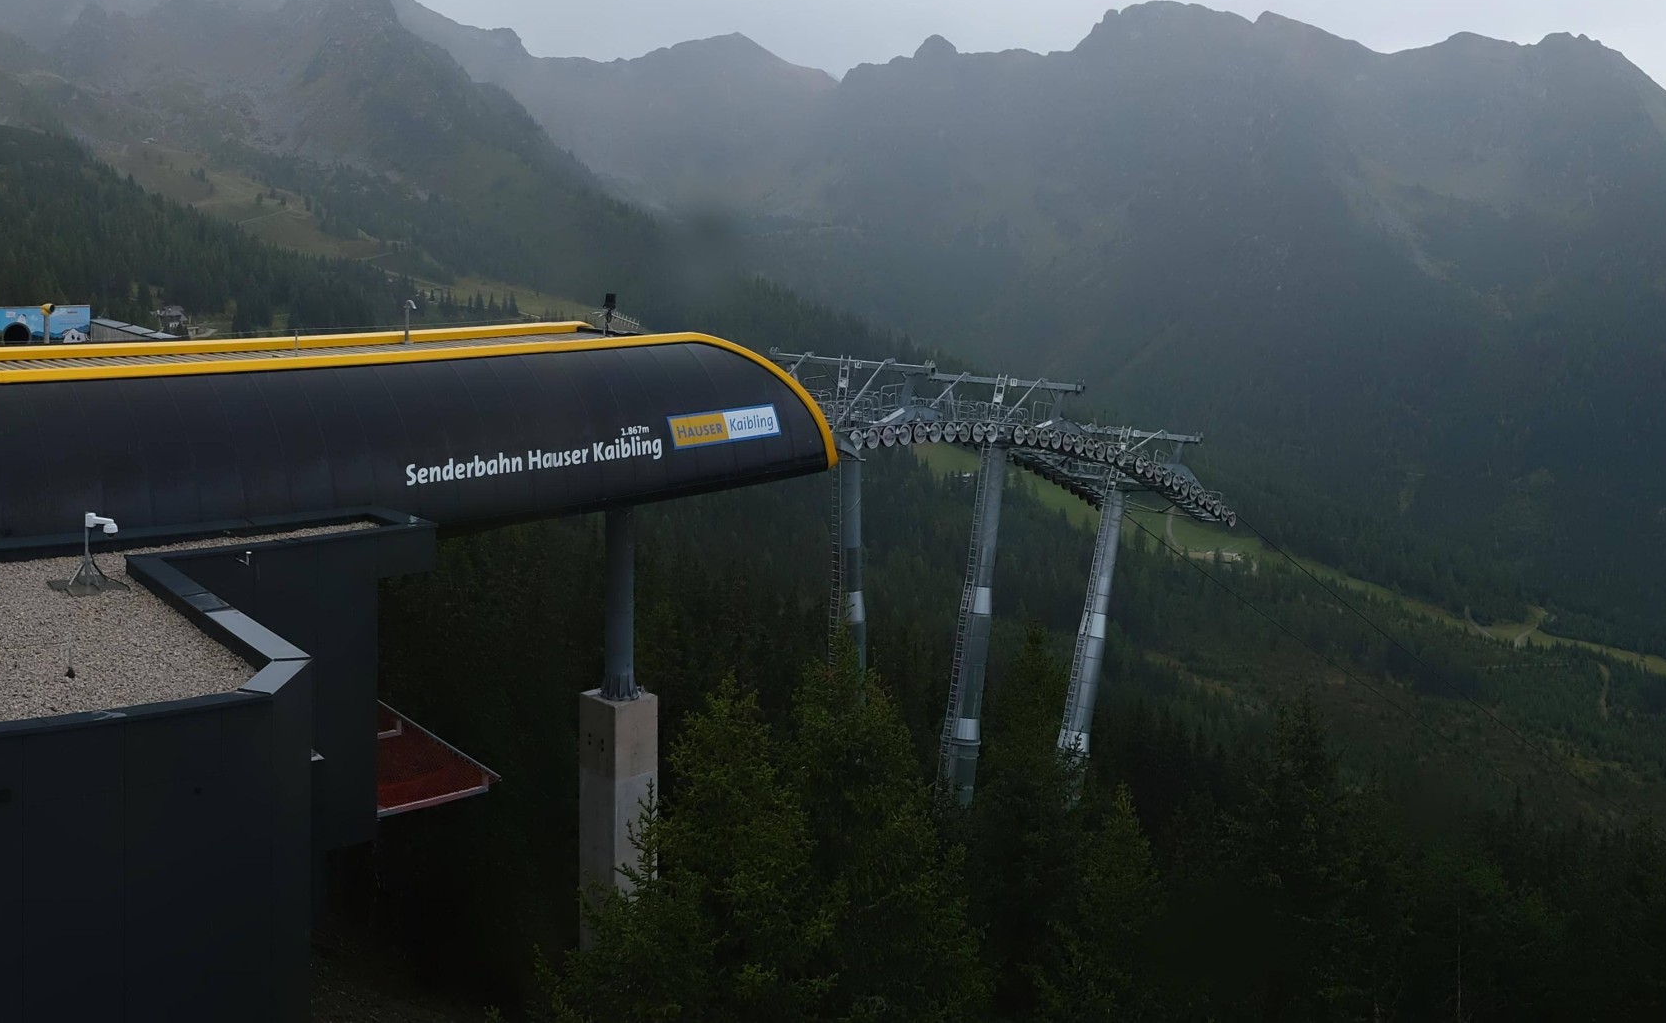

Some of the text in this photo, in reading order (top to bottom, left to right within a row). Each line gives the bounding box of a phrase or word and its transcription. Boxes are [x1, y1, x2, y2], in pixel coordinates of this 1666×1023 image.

[620, 425, 650, 437] 1.867m
[676, 415, 773, 439] HAUSER Kaibling
[406, 436, 663, 486] Senderbahn Hauser Kaibling
